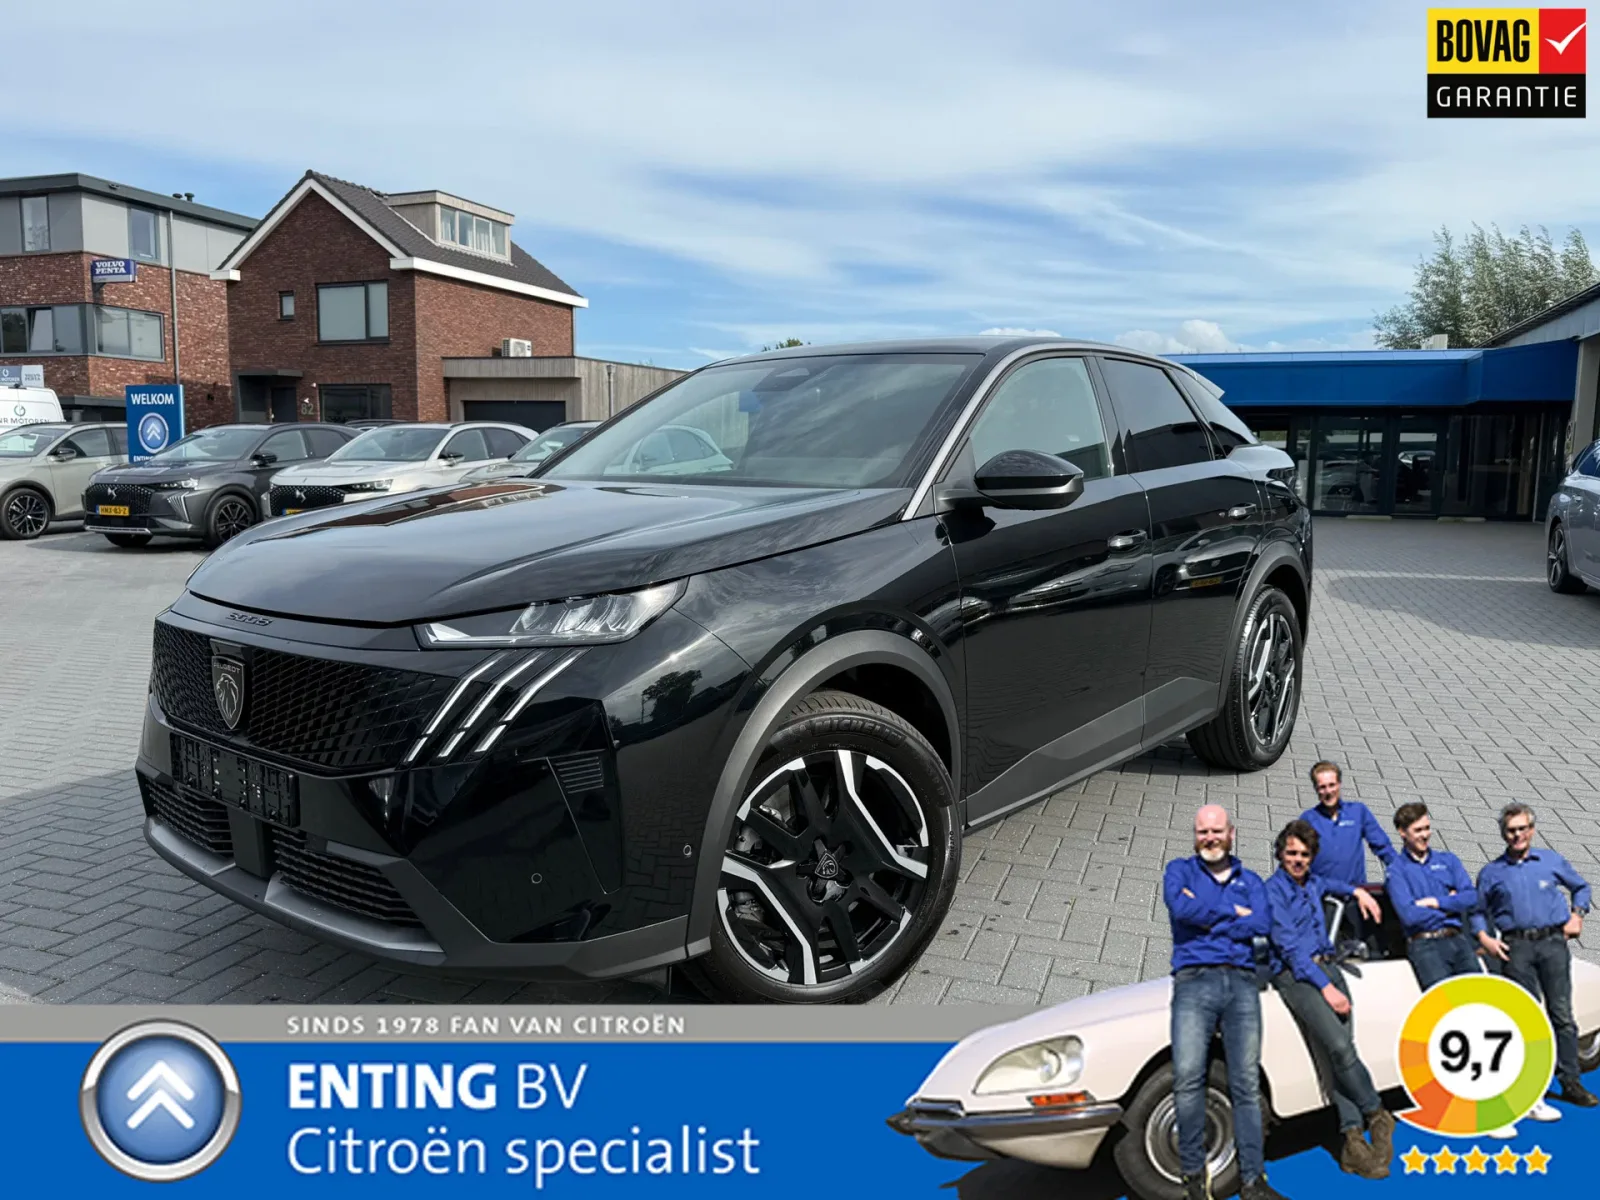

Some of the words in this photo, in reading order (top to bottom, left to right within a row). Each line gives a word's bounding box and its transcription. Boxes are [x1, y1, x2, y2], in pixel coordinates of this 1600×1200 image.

[95, 260, 125, 268] VOLVO
[131, 393, 175, 405] WELKOM
[301, 403, 314, 415] 82
[213, 662, 241, 674] PEUGEOT
[814, 719, 905, 744] MICHELIN
